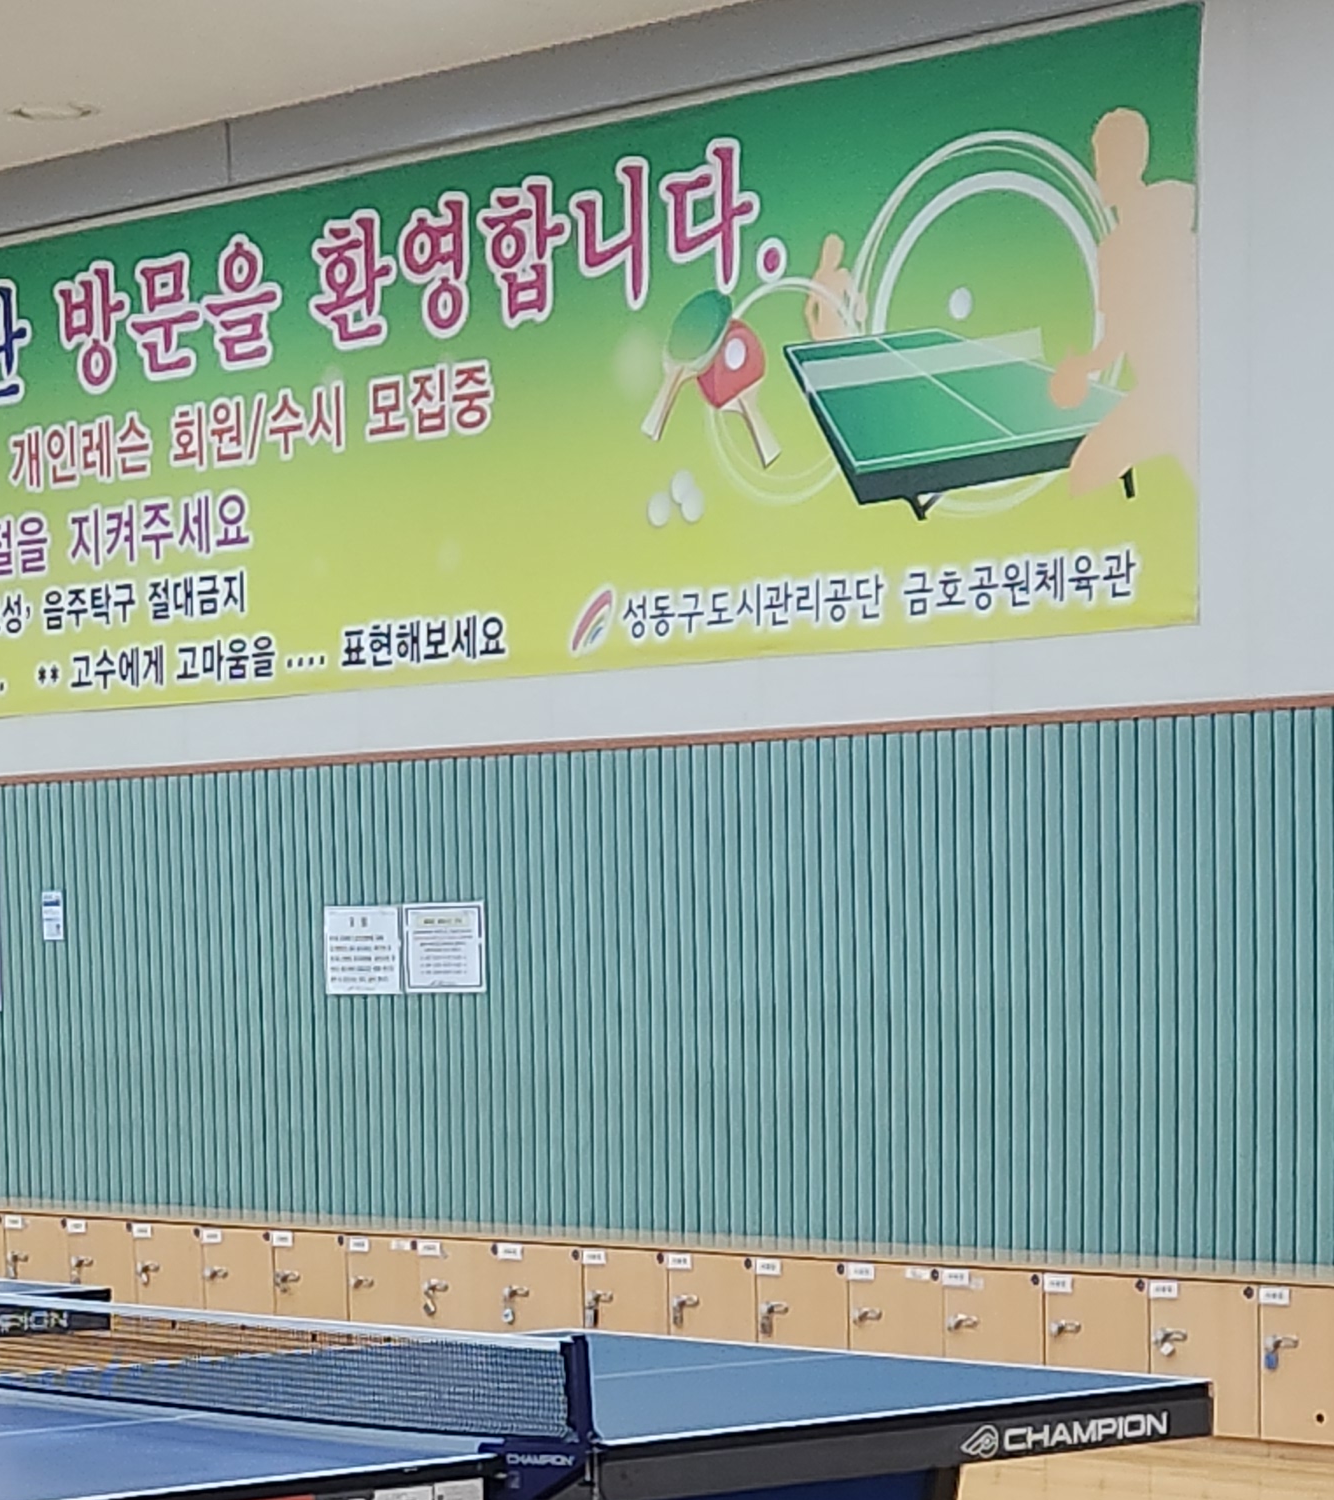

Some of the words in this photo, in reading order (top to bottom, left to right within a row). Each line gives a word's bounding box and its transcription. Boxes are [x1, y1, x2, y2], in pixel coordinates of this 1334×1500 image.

[57, 240, 279, 387] 방문을
[314, 145, 782, 343] 환영합니다.
[11, 414, 151, 487] 개인레슨
[172, 385, 345, 467] 회원/수시
[368, 365, 492, 436] 모집중
[70, 494, 250, 567] 지켜주세요
[43, 583, 136, 630] 음주탁구
[148, 570, 246, 619] 절대금지
[621, 573, 884, 638] 성동구도시관리공단
[902, 549, 1137, 616] 금호공원체육관
[70, 643, 165, 690] 고수에게
[340, 614, 507, 667] 표현해보세요
[505, 1453, 575, 1467] CHAMPION
[1003, 1411, 1169, 1452] CHAMPION
